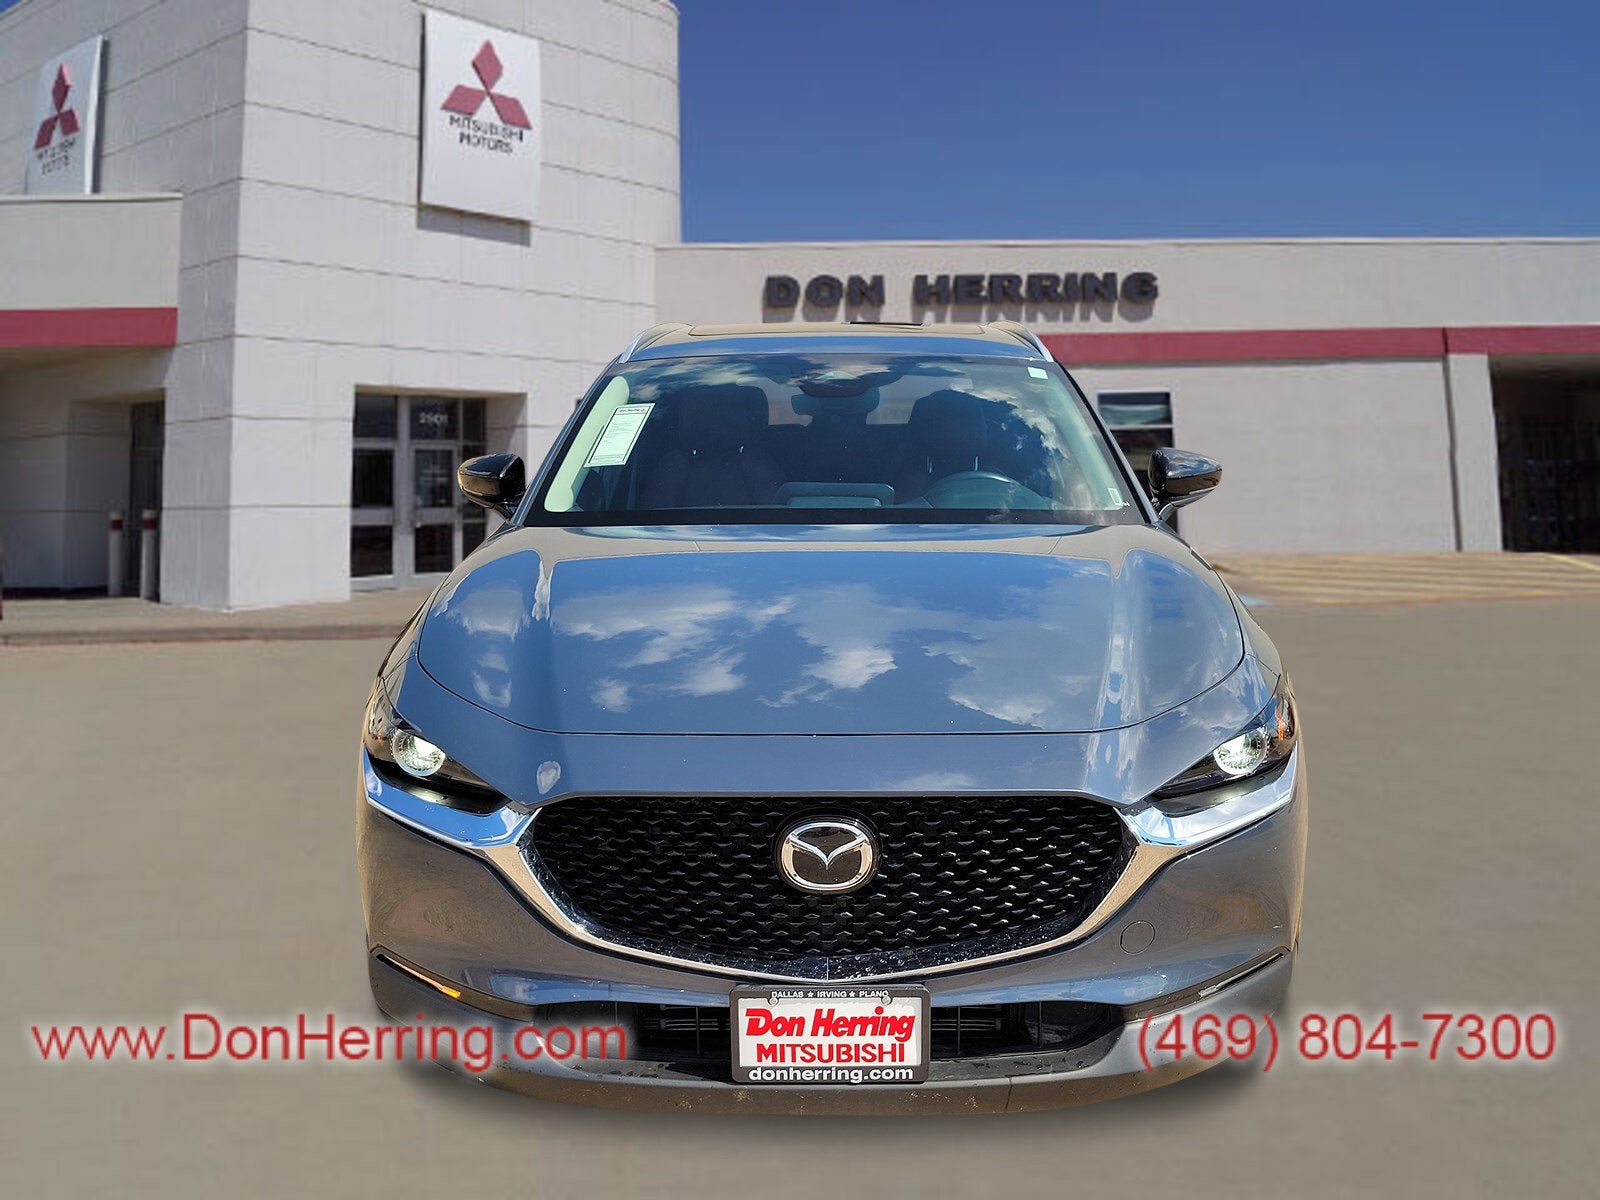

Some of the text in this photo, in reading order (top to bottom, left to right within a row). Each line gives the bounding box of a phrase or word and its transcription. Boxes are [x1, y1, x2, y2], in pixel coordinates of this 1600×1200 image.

[458, 131, 514, 153] MOTORS
[763, 271, 1159, 307] DON HERRING
[771, 990, 889, 998] DALLAS IRVING PLANO
[745, 1006, 916, 1042] Don Herring
[756, 1043, 905, 1063] MITSUBISHI
[748, 1066, 914, 1084] donherring.com
